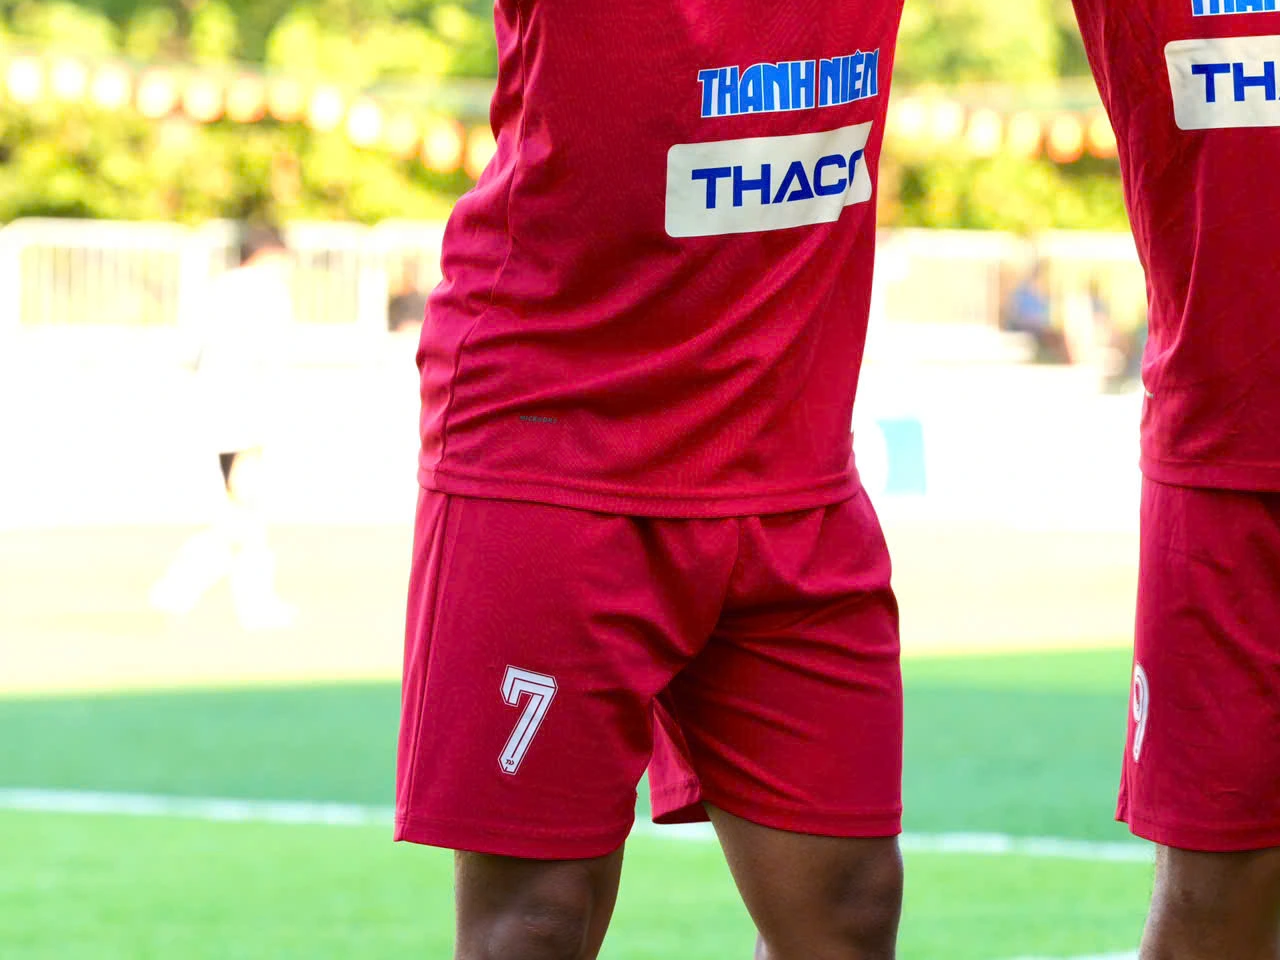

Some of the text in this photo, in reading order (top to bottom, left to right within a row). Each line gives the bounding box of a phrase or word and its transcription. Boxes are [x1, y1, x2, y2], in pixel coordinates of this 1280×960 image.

[697, 48, 880, 117] THANH NIÊN
[498, 664, 558, 775] 7
[1132, 660, 1150, 763] 9
